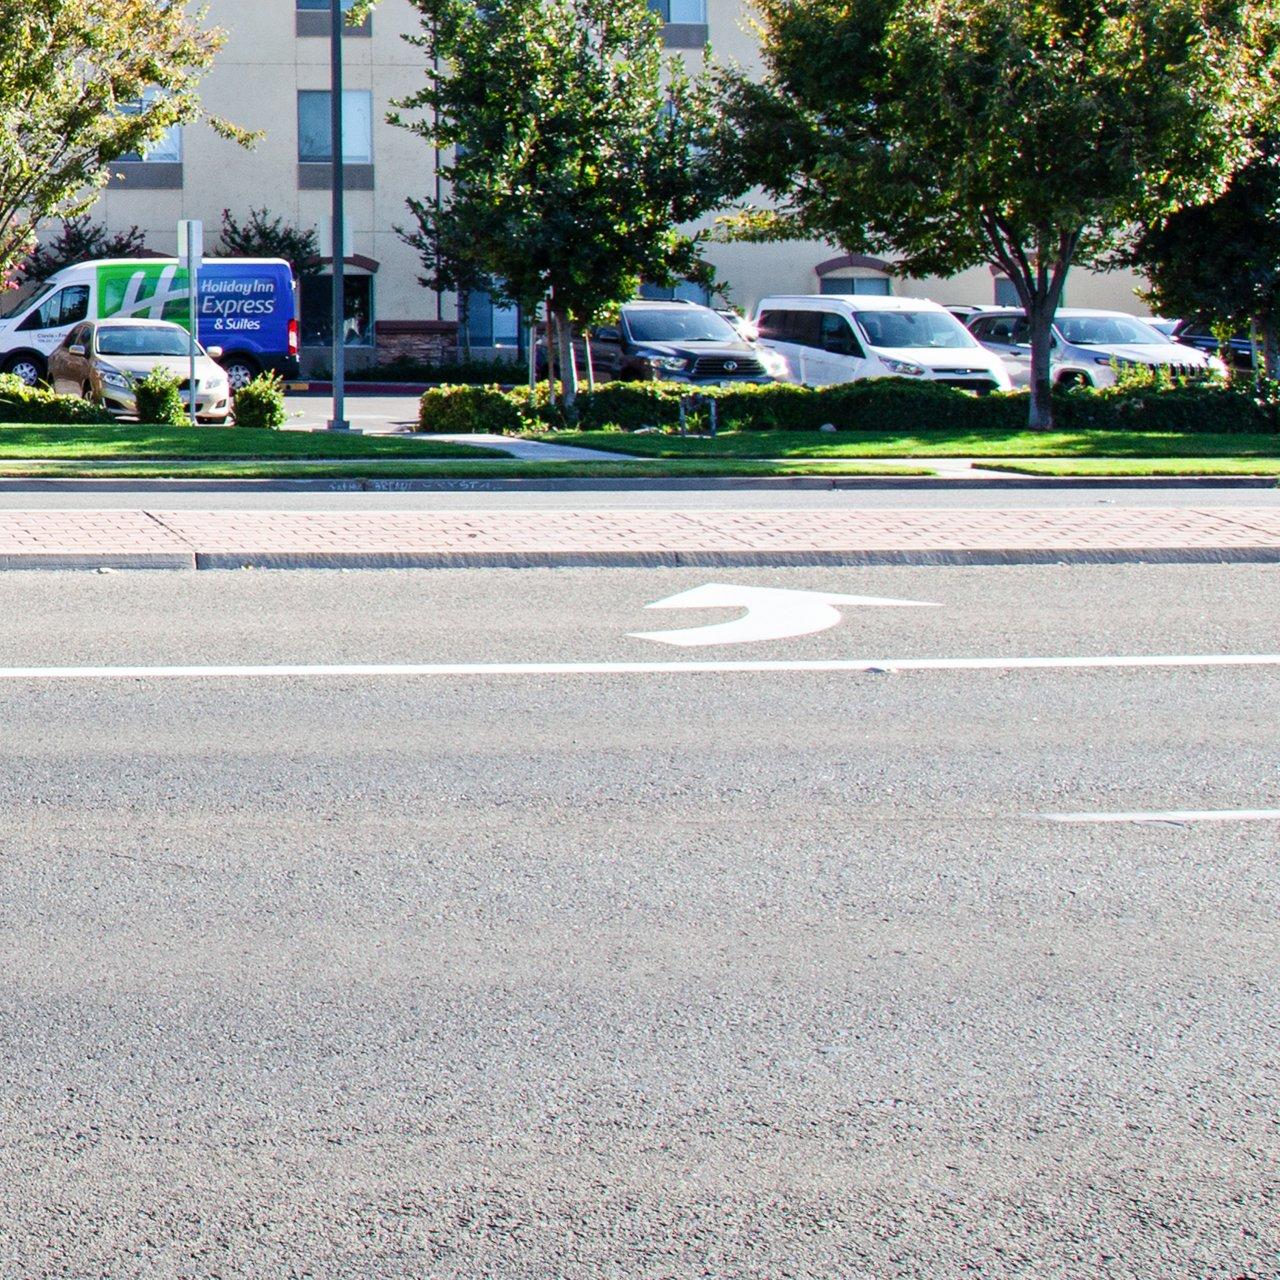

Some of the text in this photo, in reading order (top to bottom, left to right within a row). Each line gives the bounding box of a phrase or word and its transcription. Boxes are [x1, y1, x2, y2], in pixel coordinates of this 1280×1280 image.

[201, 280, 274, 295] Holiday Inn
[202, 295, 274, 317] Express
[214, 318, 260, 330] & Suites
